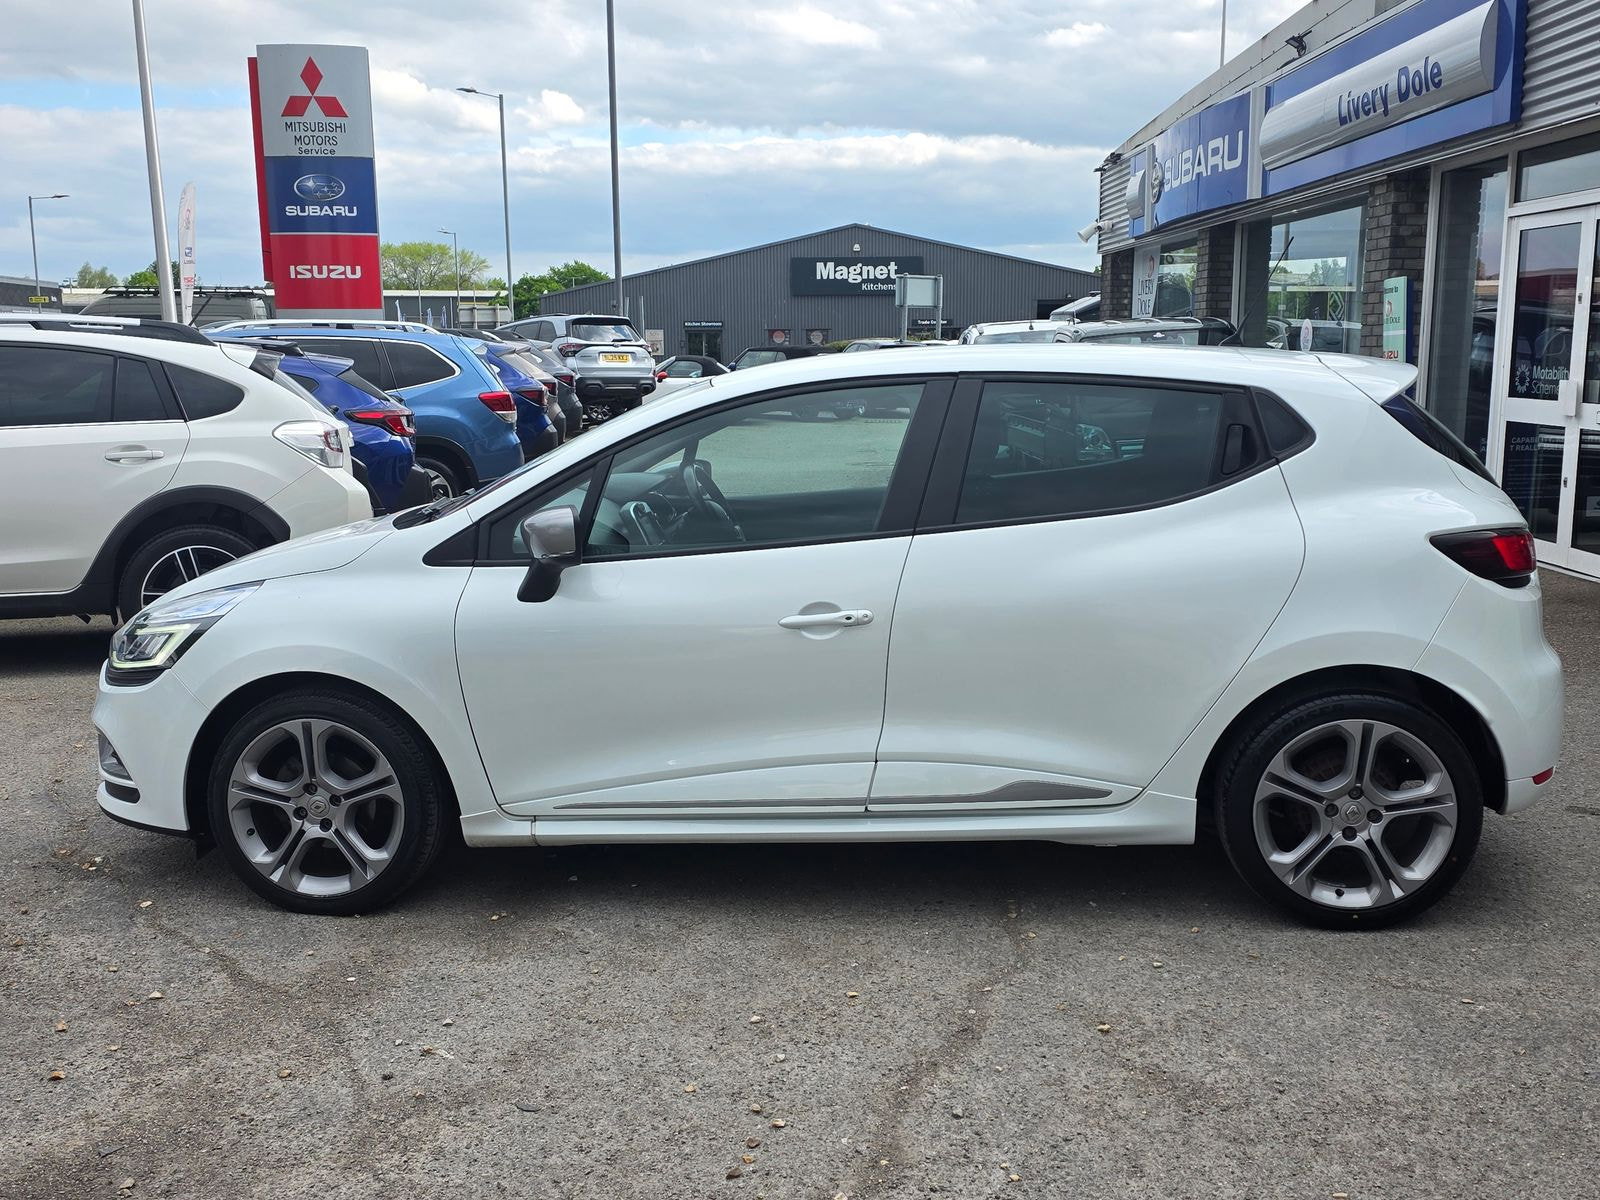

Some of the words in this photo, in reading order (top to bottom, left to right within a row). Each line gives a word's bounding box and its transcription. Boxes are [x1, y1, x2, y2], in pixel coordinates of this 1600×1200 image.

[1338, 83, 1389, 126] Livery
[1397, 56, 1443, 103] Dole
[284, 121, 346, 133] MITSUBISHI
[294, 135, 338, 146] MOTORS
[298, 146, 336, 156] Service
[1164, 130, 1243, 193] SUBARU
[285, 205, 358, 217] SUBARU
[289, 265, 362, 279] ISUZU
[816, 261, 898, 283] Magnet
[862, 283, 896, 291] Kitchens
